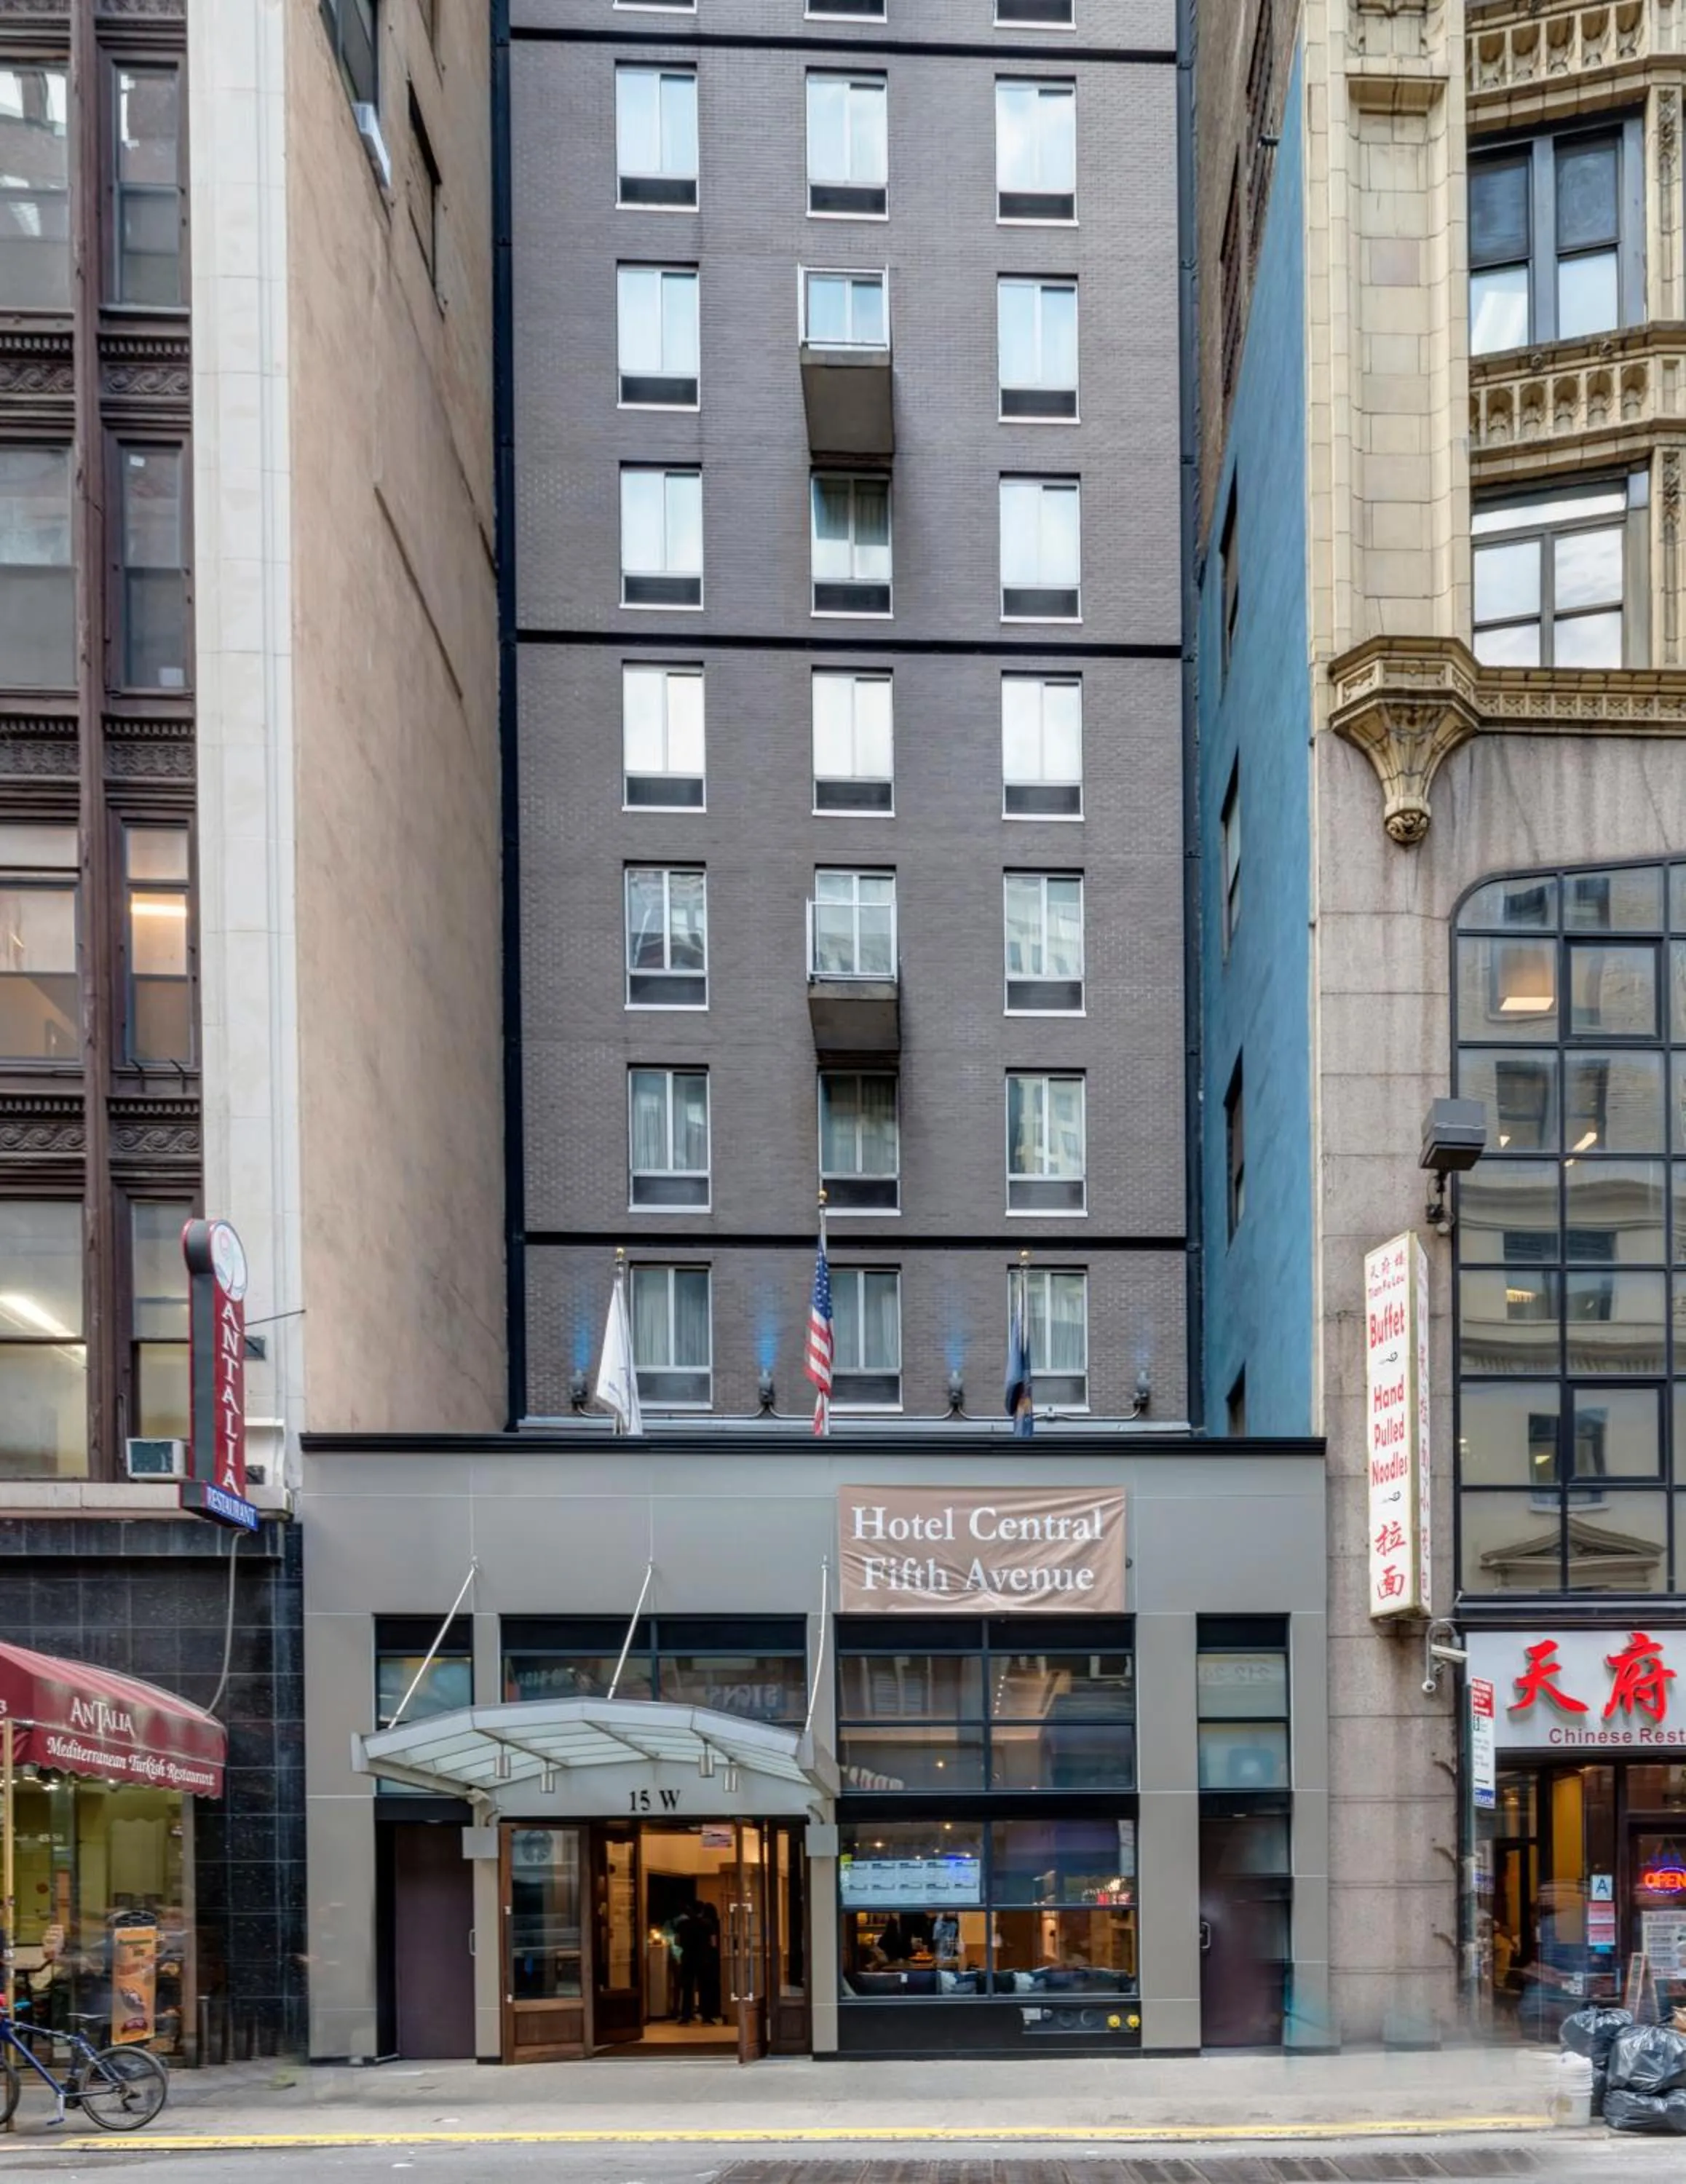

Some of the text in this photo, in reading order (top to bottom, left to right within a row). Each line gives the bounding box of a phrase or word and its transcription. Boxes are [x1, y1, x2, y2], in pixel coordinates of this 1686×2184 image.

[1370, 1301, 1405, 1348] Buffet
[221, 1302, 242, 1497] ANTALIA
[1374, 1374, 1405, 1413] Hand
[1374, 1412, 1405, 1449] Pulled
[1372, 1452, 1409, 1487] Noodles
[207, 1487, 256, 1527] RESTAURANT
[850, 1506, 1104, 1541] Hotel Central
[860, 1556, 1096, 1593] Fifth Avenue
[1374, 1521, 1406, 1600] 拉面
[1505, 1631, 1677, 1724] 天府
[1548, 1728, 1686, 1744] Chinese Rest
[47, 1736, 215, 1785] Mediterranean Turkish Restaurant
[629, 1789, 681, 1811] 15 W
[1596, 1878, 1608, 1893] A
[1645, 1872, 1686, 1888] OPEN
